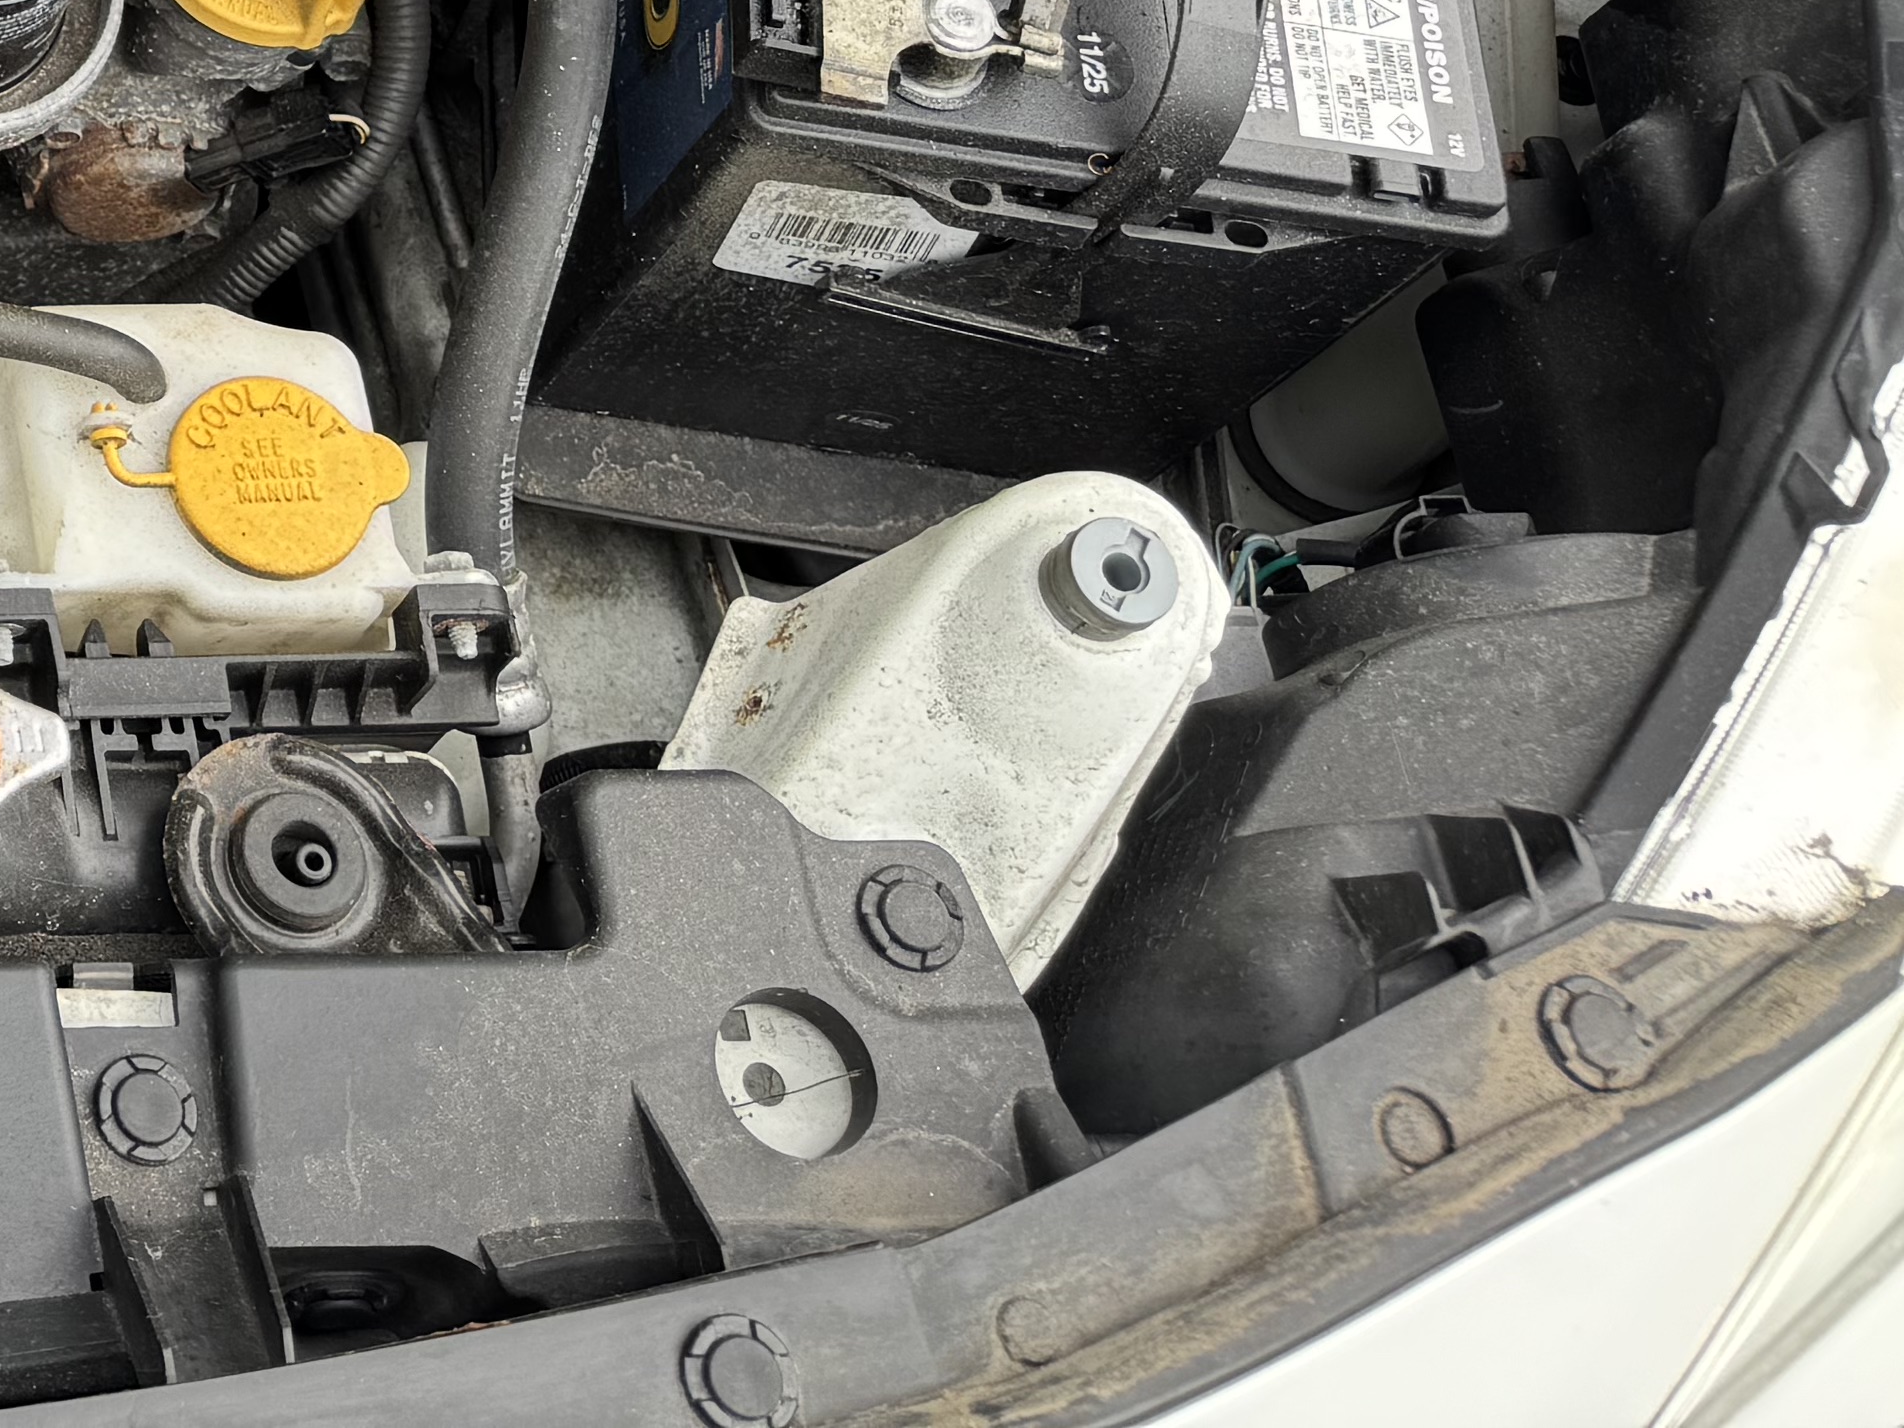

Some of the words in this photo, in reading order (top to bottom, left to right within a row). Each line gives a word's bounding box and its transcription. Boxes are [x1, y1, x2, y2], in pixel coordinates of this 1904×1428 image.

[1291, 25, 1306, 41] DO
[1306, 28, 1319, 43] DO
[1076, 31, 1110, 95] 11/25
[1294, 42, 1309, 62] NOT
[1362, 38, 1379, 64] WITH
[1395, 43, 1413, 75] FLUSH
[1269, 67, 1286, 85] DO
[1349, 74, 1367, 93] GET
[1367, 66, 1387, 104] WATER.
[1379, 40, 1404, 110] IMMEDIATELY
[1255, 83, 1273, 109] FOR
[1272, 86, 1290, 113] NOT
[1335, 83, 1353, 109] HELP
[1401, 76, 1419, 103] EYES
[1354, 96, 1376, 141] MEDICAL
[1448, 132, 1466, 158] 12V
[185, 384, 346, 450] COOLANT
[240, 436, 286, 459] SEE
[232, 458, 317, 483] OWNERS
[235, 481, 323, 505] MANUAL
